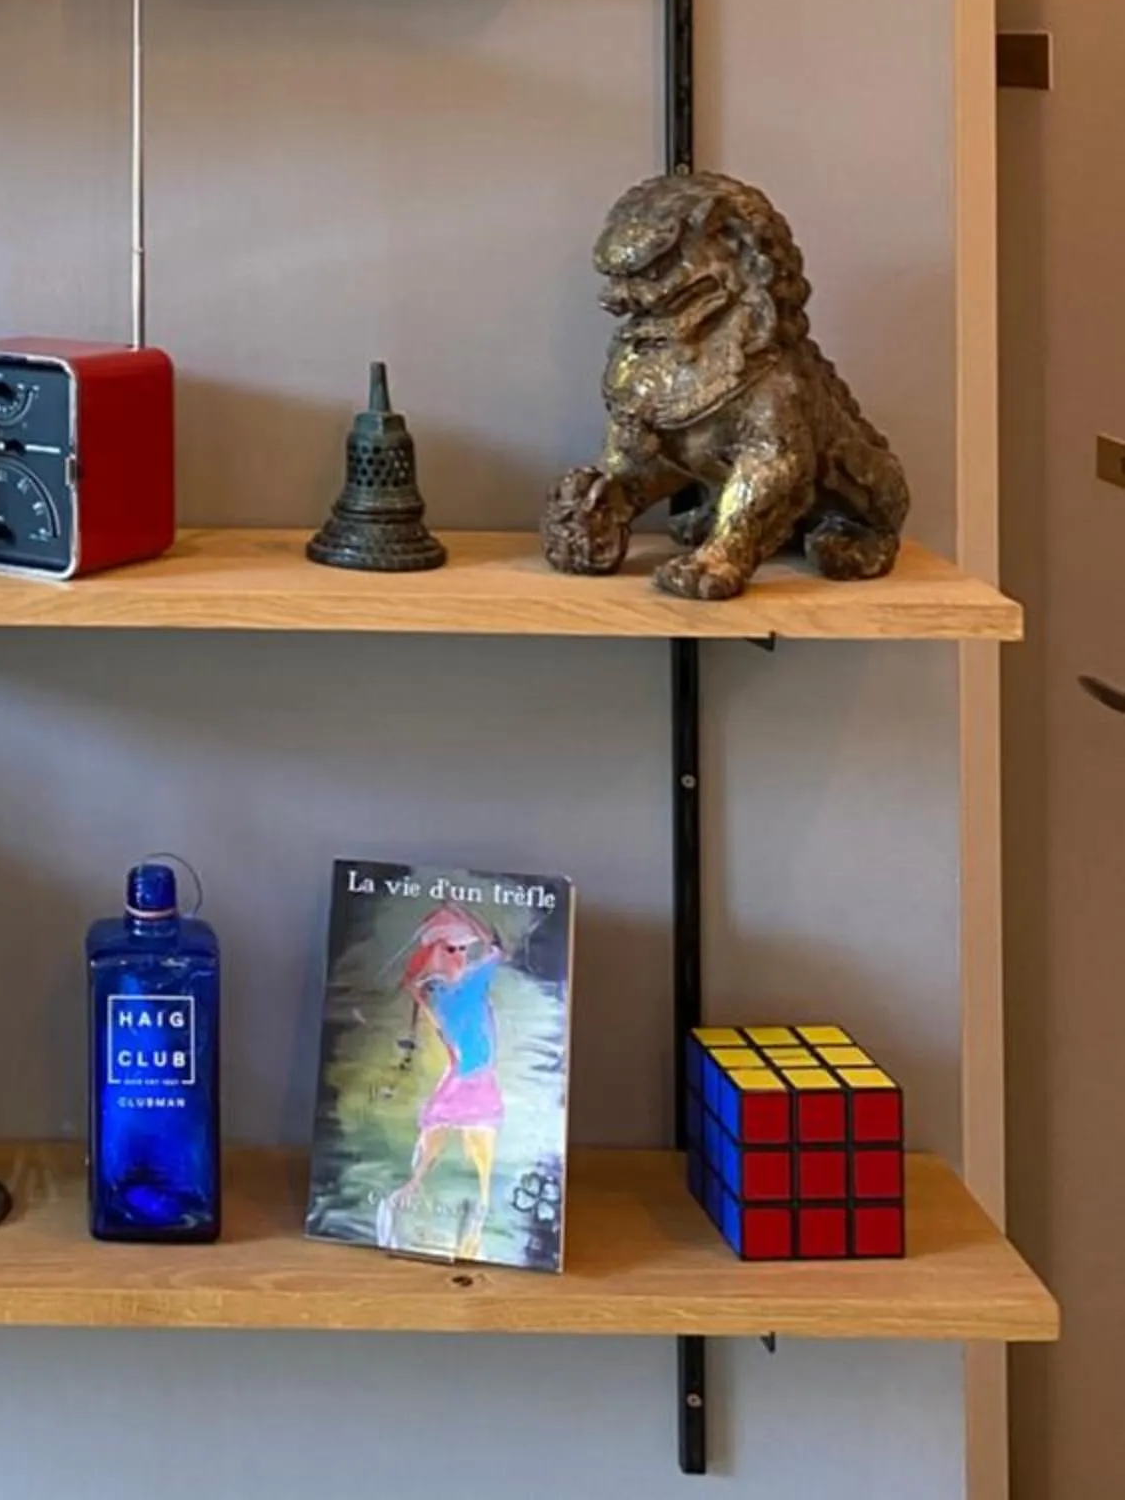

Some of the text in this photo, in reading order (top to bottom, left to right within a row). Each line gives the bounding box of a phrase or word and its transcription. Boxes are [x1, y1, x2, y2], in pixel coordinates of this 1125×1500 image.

[347, 869, 556, 909] La vie d'un trèfle
[118, 1010, 186, 1028] HAIG
[117, 1049, 187, 1068] CLUB
[116, 1096, 187, 1109] CLUBMAN
